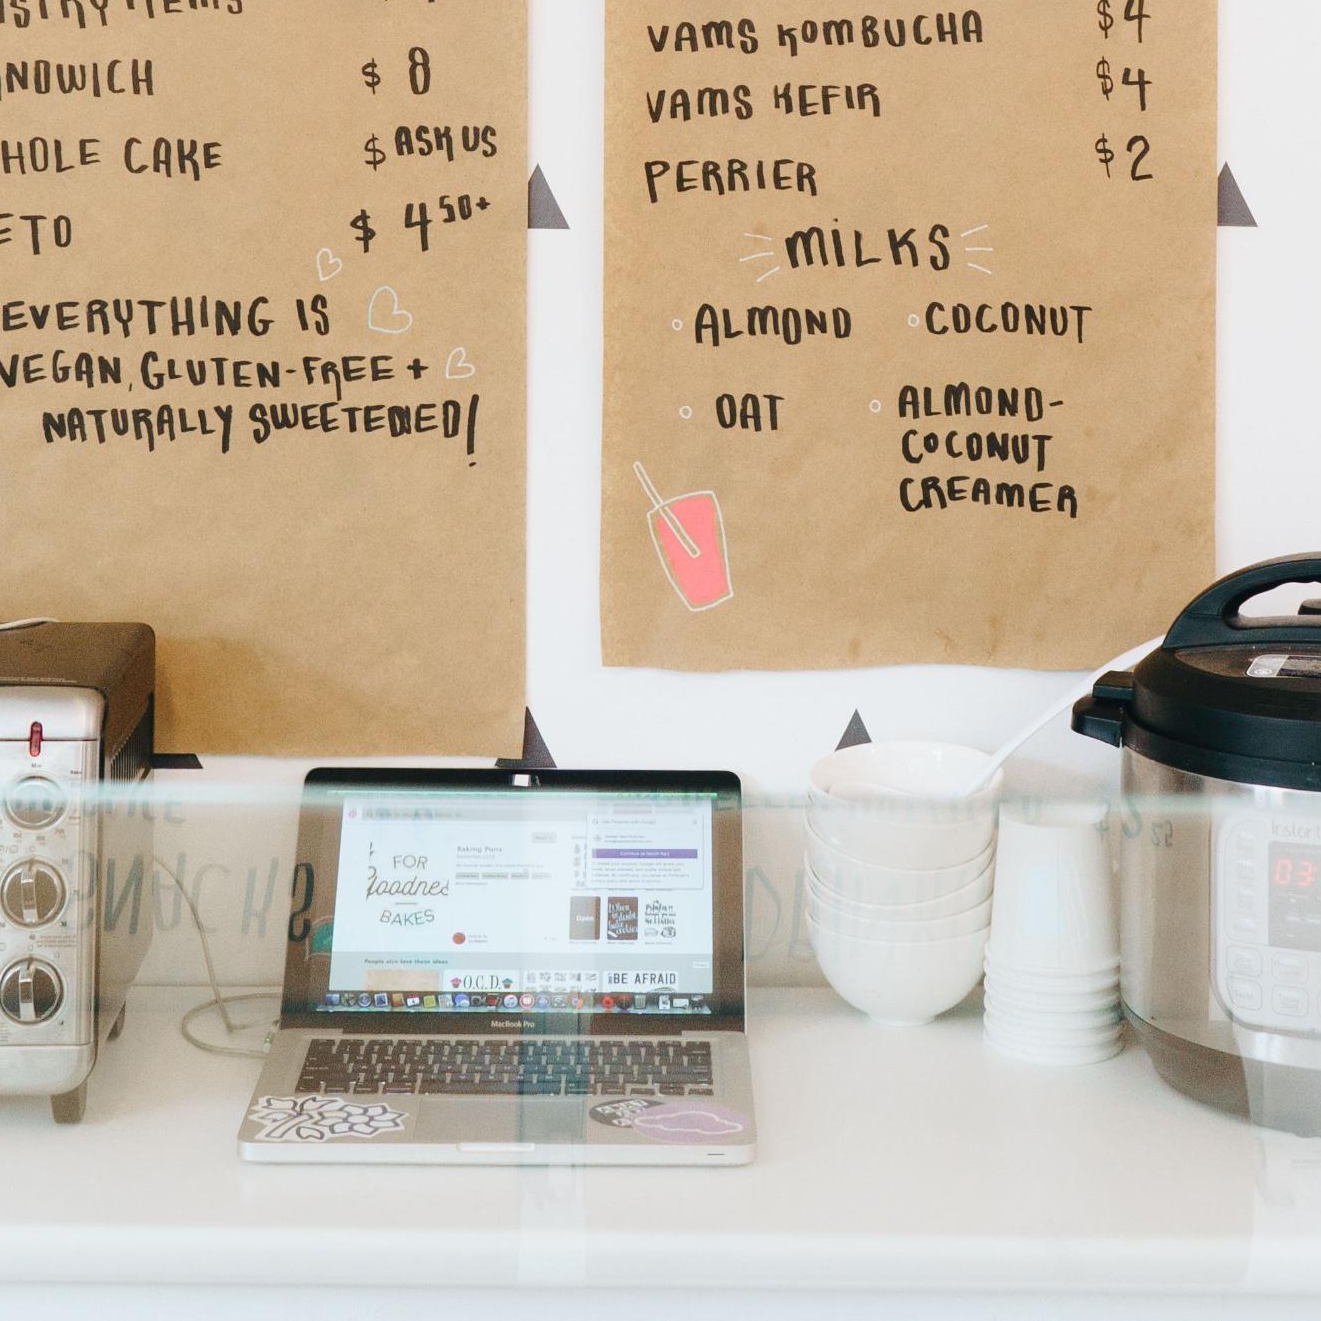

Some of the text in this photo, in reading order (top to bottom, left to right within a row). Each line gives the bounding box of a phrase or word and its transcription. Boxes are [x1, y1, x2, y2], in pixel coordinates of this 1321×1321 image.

[646, 9, 984, 58] VAMS KOMBUCHA
[645, 82, 881, 124] VAMS KEFIR
[123, 136, 223, 182] CAKE
[644, 158, 818, 204] PERRIER
[2, 293, 330, 339] EVERYTHING IS
[694, 302, 852, 348] ALMOND
[925, 301, 1093, 344] COCONUT
[140, 350, 396, 402] GLUTEN-FREE
[715, 392, 785, 433] OAT
[897, 381, 1064, 423] ALMOND-
[42, 403, 233, 455] NATURALLY
[901, 428, 1054, 473] COCONUT
[899, 475, 1078, 519] CREAMER
[393, 854, 428, 869] FOR
[379, 909, 435, 926] BAKES
[613, 973, 628, 984] BE
[634, 973, 676, 984] AFRAID
[491, 1020, 535, 1028] MacBook Pro
